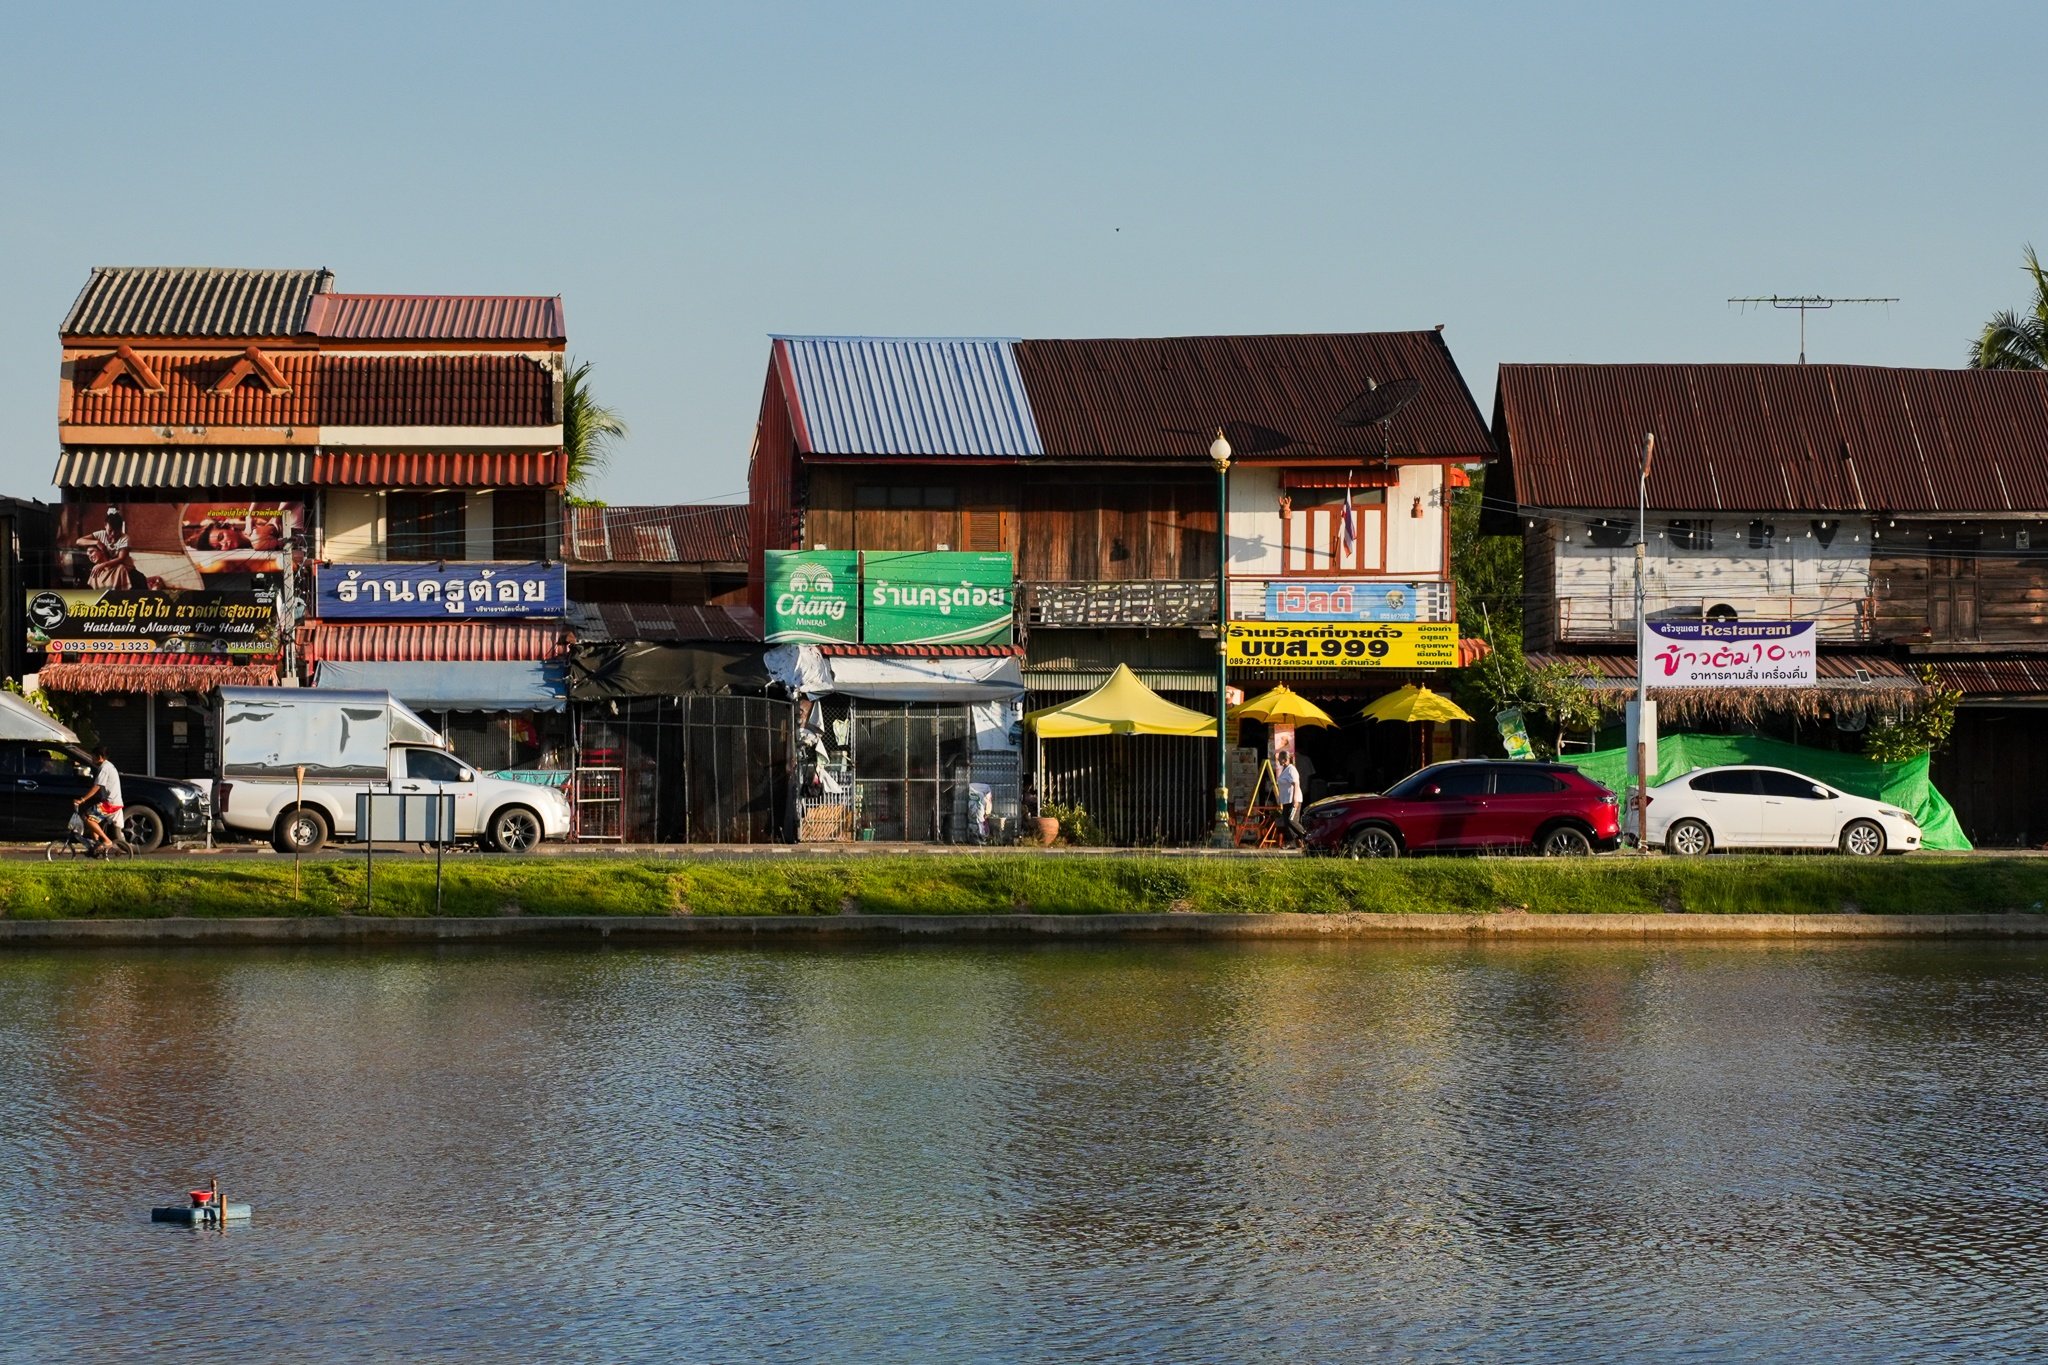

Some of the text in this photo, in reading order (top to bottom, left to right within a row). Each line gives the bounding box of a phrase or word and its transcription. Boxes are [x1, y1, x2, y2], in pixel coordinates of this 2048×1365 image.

[337, 569, 546, 614] ร้านครูต้อย
[872, 579, 1005, 615] ร้านครูต้อย
[1276, 585, 1355, 614] เวิลด์
[776, 593, 847, 620] Chang
[83, 621, 255, 635] Hatthasin Massage For Health
[1701, 625, 1792, 636] Restaurant
[64, 642, 149, 651] 093-992-1323
[230, 641, 273, 650] 마사지하다
[1241, 639, 1389, 657] บขส.999
[1690, 666, 1808, 680] อาหารตามสั่ง เครื่องดื่ม
